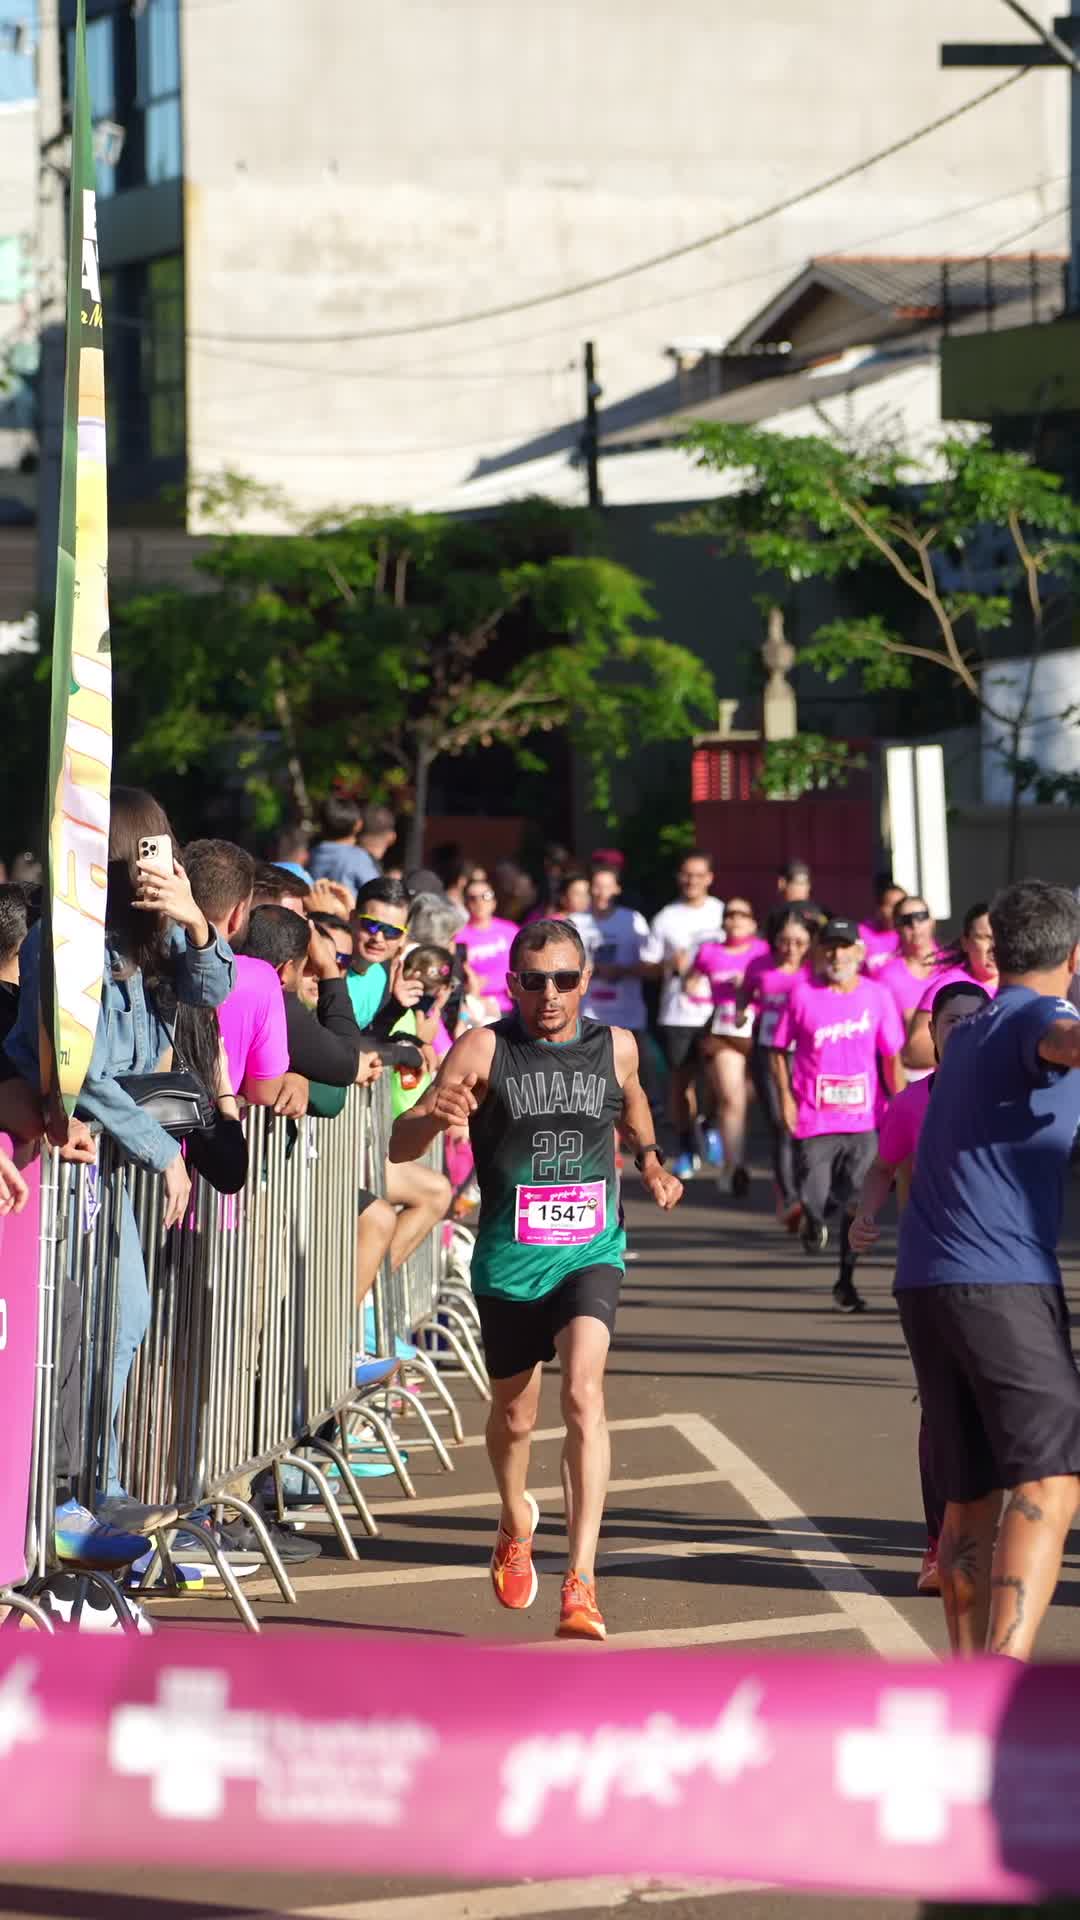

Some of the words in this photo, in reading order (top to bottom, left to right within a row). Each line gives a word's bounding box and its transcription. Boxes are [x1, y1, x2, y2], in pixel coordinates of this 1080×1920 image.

[506, 1072, 606, 1119] MIAMI
[531, 1130, 584, 1183] 22
[538, 1205, 586, 1222] 1547
